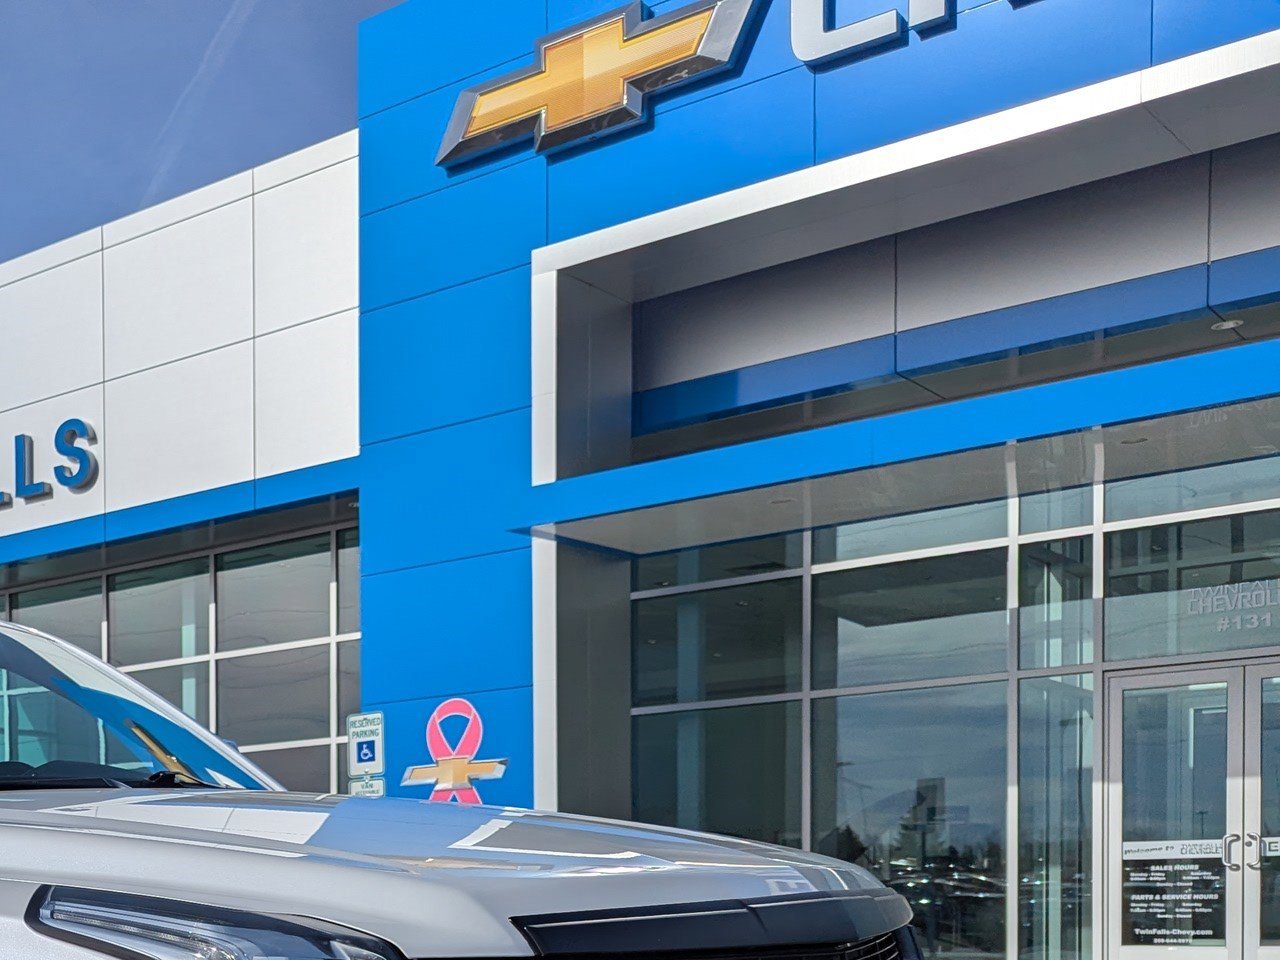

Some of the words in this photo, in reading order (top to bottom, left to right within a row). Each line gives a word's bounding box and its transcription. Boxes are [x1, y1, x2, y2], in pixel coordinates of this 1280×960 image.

[1188, 589, 1280, 615] CHEVROL
[1217, 612, 1272, 632] #131
[349, 717, 381, 729] RESERVED
[351, 728, 380, 739] PARKING
